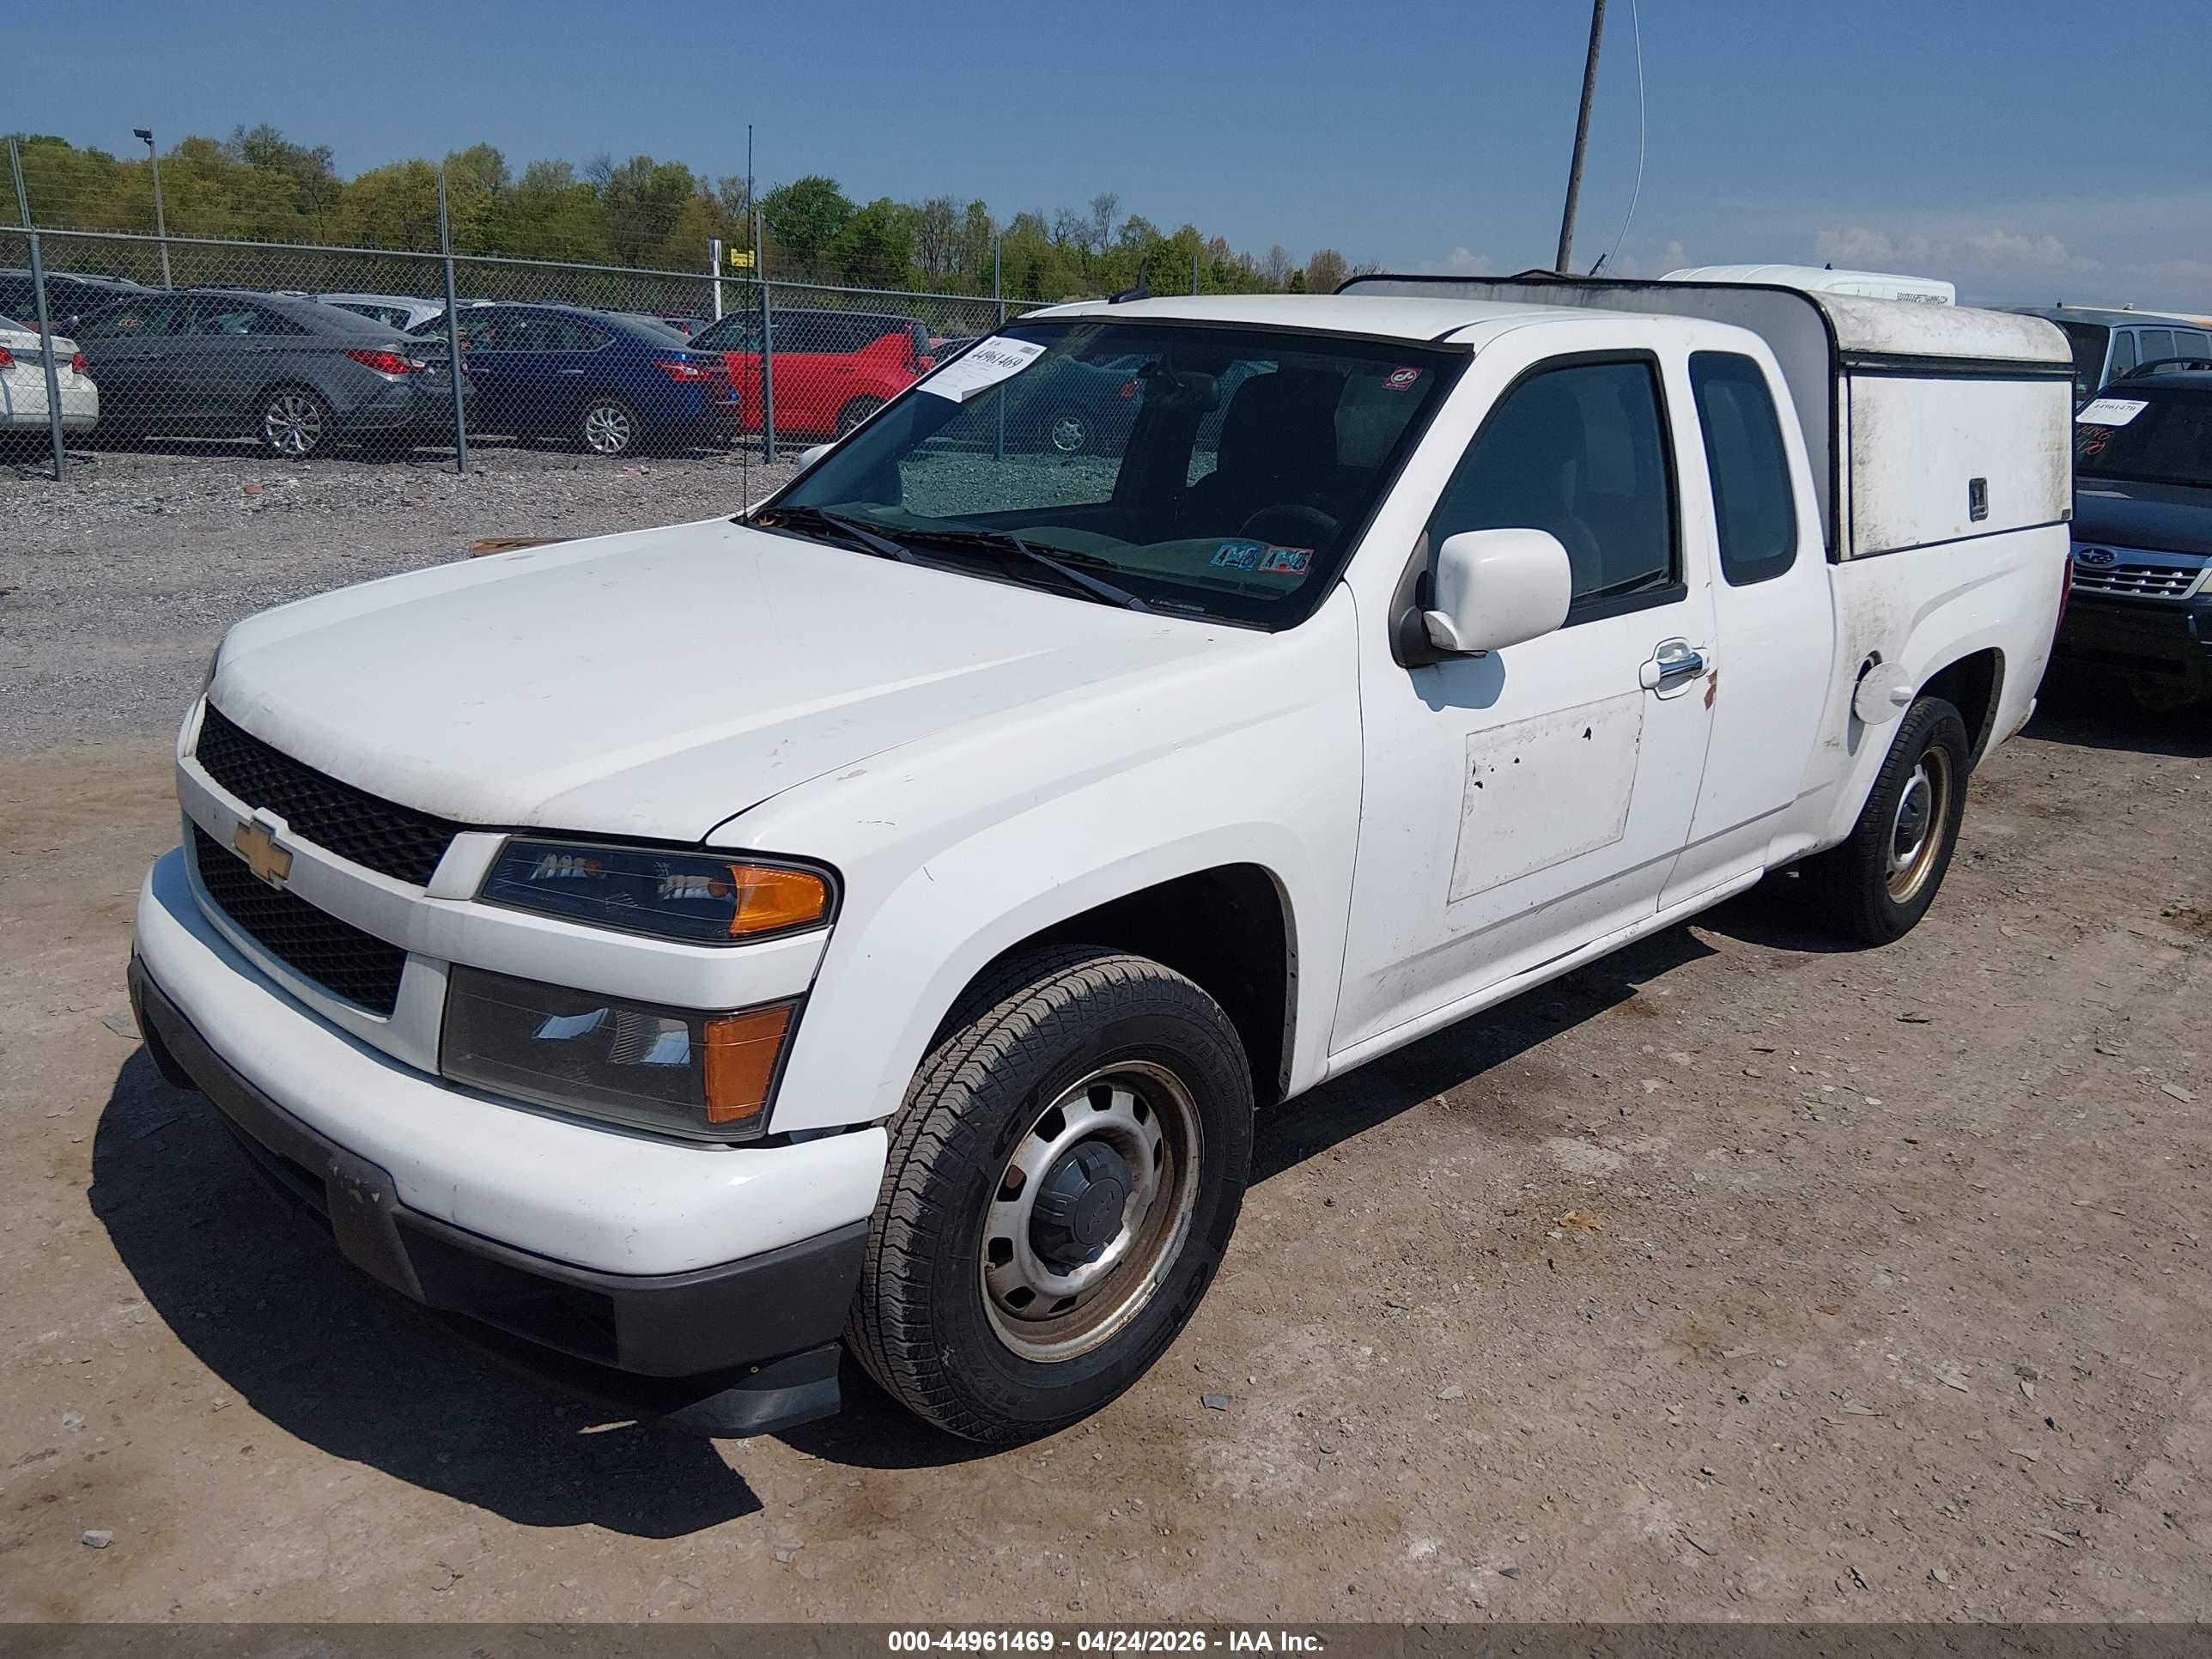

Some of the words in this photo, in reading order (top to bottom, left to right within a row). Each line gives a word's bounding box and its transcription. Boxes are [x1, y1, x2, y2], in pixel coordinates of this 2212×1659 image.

[971, 349, 1024, 368] 44961469
[1216, 550, 1228, 564] 4
[1266, 553, 1278, 568] 4
